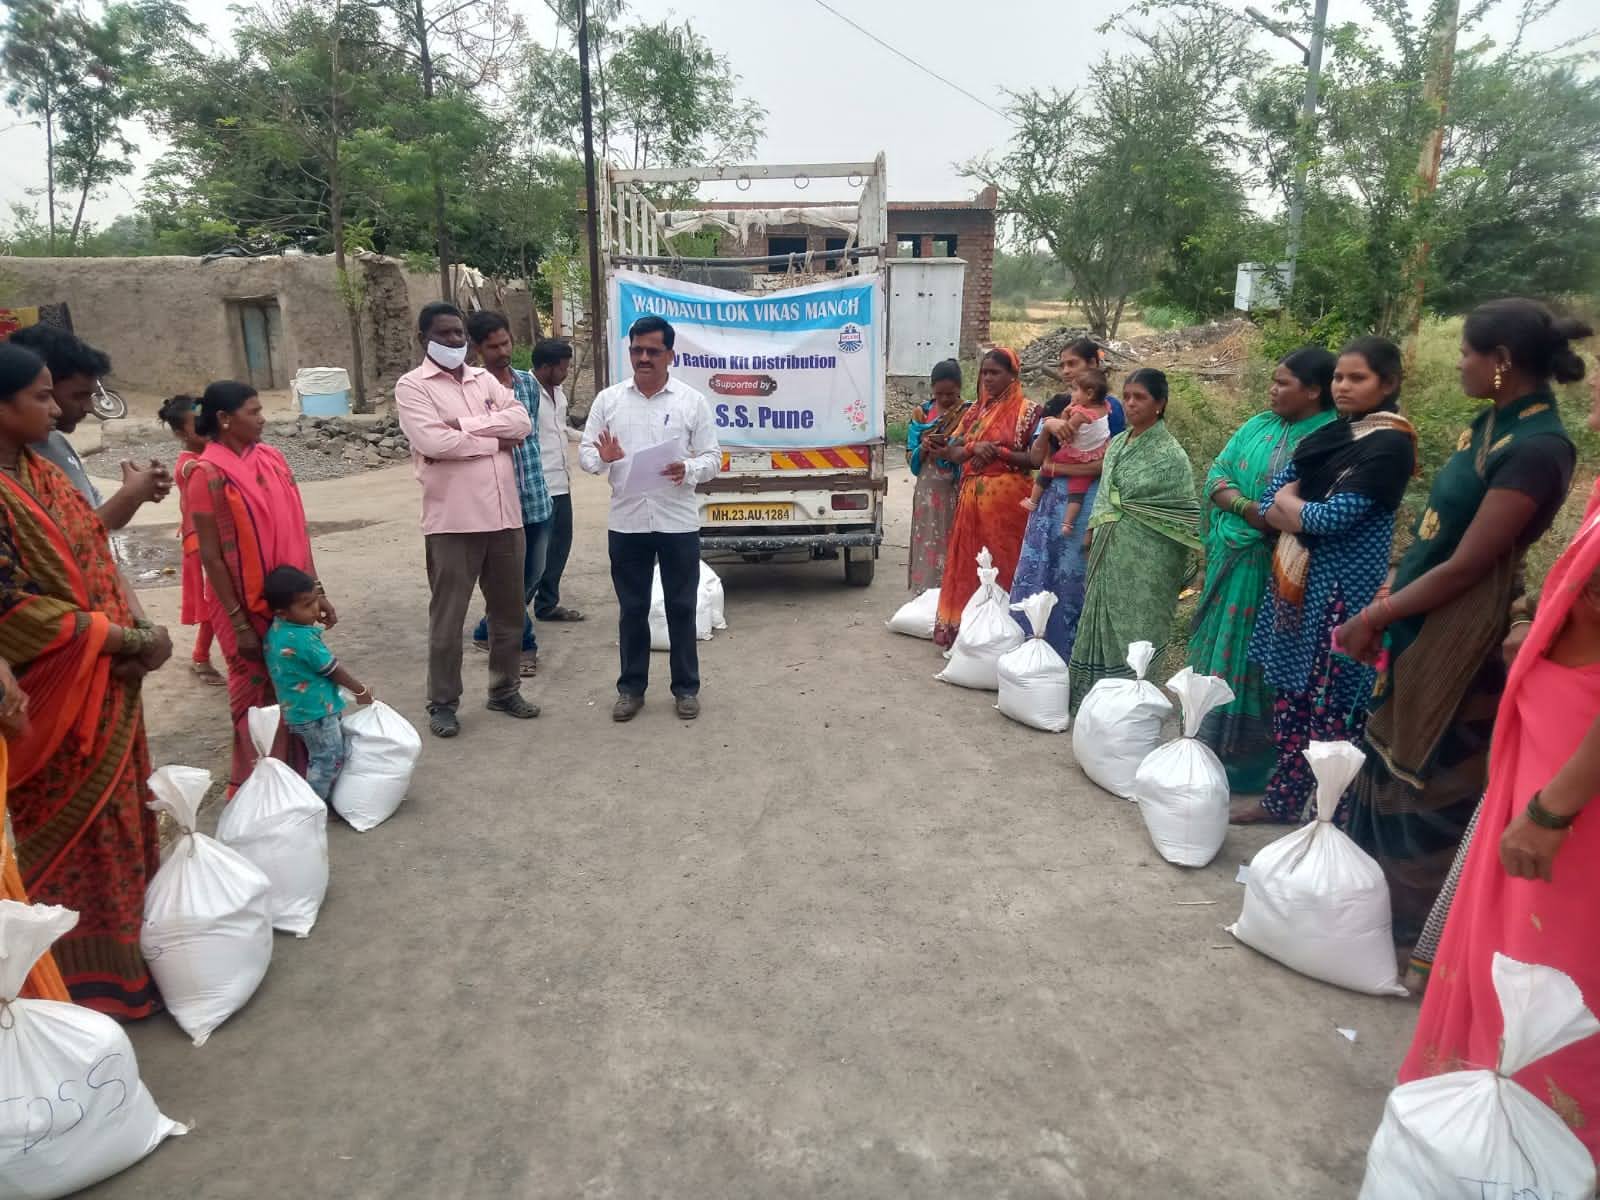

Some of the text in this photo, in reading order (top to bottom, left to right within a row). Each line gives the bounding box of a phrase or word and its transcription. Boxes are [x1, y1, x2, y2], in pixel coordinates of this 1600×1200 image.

[632, 294, 859, 322] WADMAVLI LOK VIKAS MANCH
[682, 352, 727, 369] Ration
[729, 355, 750, 370] Kit
[752, 354, 836, 370] Distribution
[715, 379, 772, 391] Supported by
[715, 403, 814, 429] S.S. Pune
